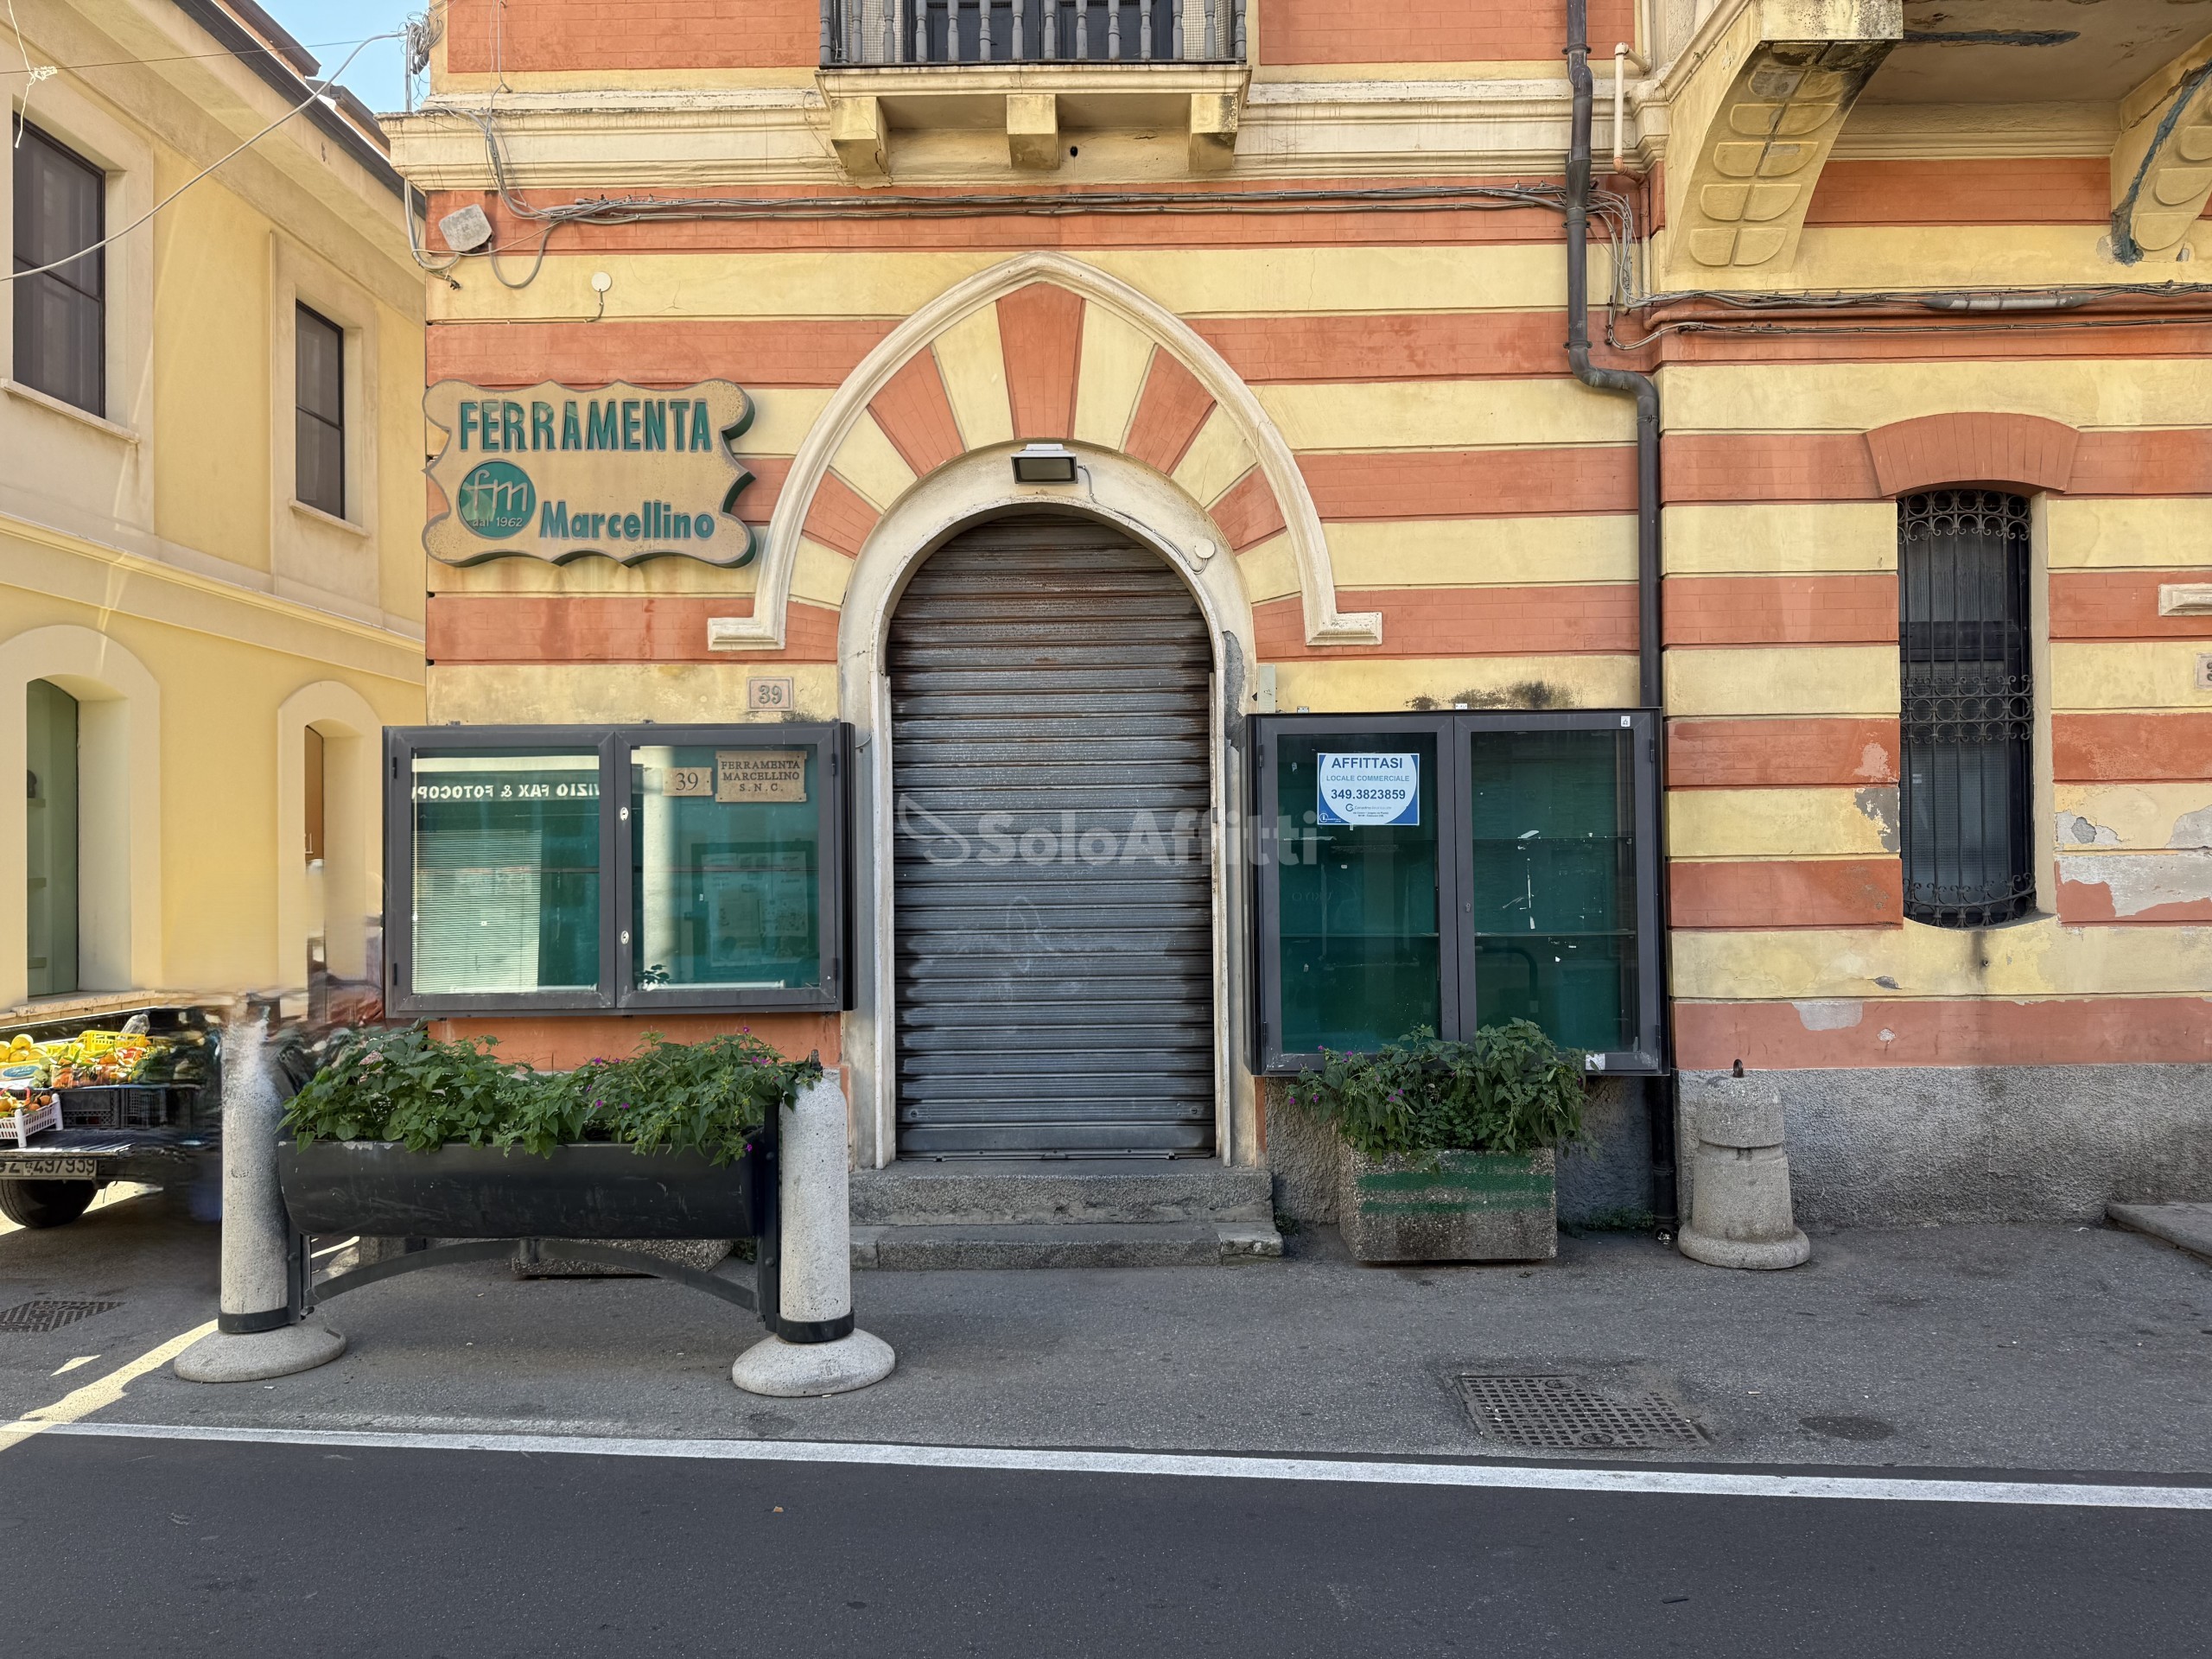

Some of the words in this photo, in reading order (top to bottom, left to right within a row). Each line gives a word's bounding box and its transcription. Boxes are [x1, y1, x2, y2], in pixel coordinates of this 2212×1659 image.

[459, 399, 713, 452] FERRAMENTA
[473, 517, 489, 527] dal
[496, 517, 523, 527] 1962
[539, 499, 715, 540] Marcellino
[759, 685, 782, 704] 39
[721, 760, 800, 769] FERRAMENTA
[1332, 758, 1402, 769] AFFITTASI
[676, 772, 698, 791] 39
[722, 772, 799, 781] MARCELLINO
[1331, 789, 1406, 799] 349.3823859
